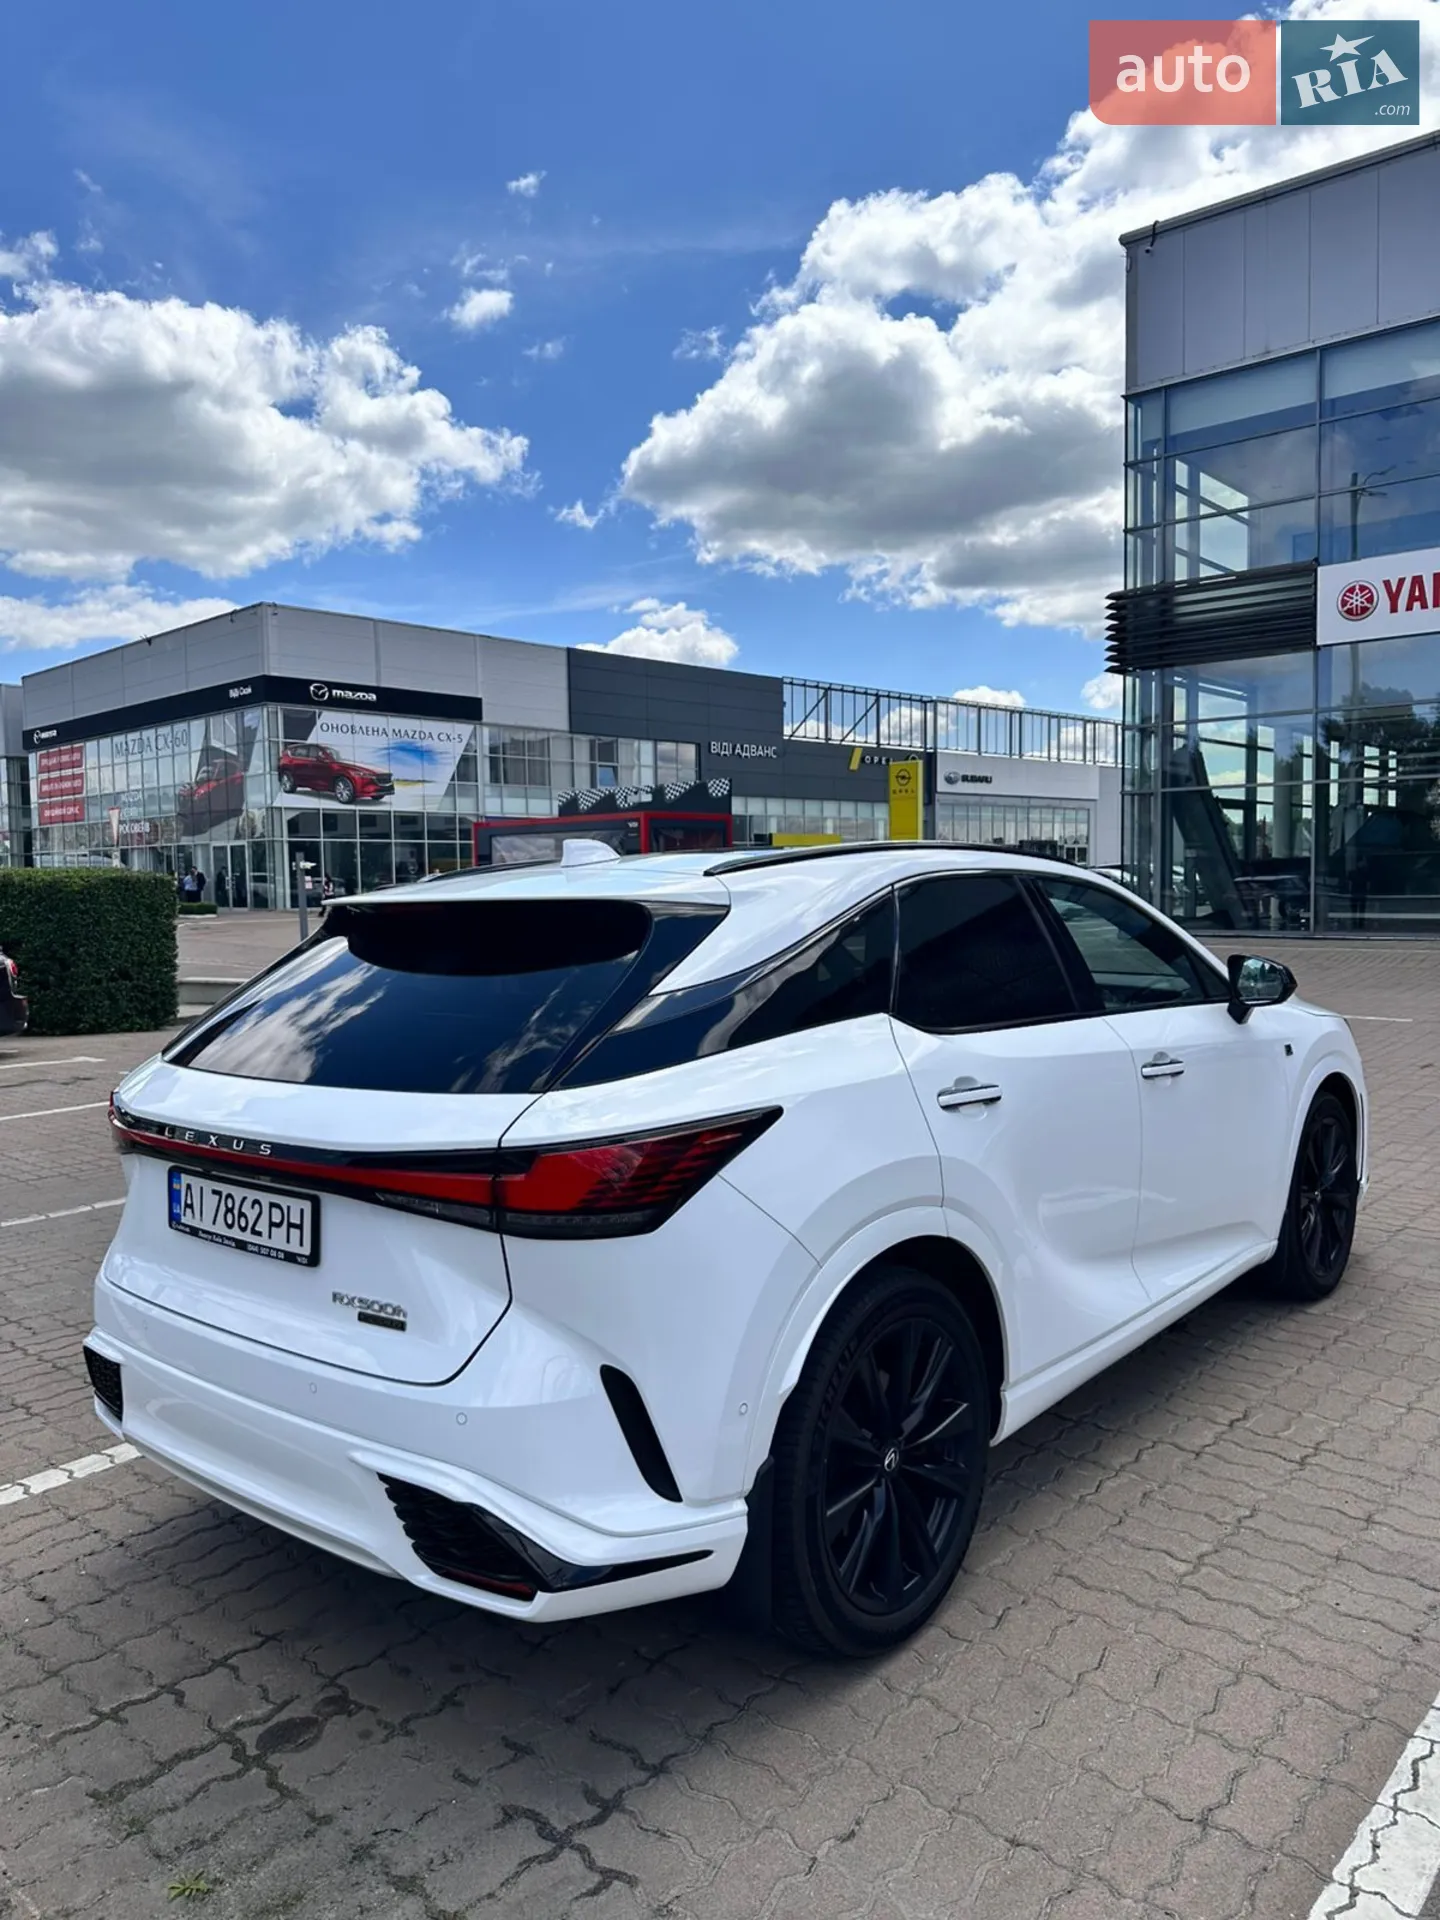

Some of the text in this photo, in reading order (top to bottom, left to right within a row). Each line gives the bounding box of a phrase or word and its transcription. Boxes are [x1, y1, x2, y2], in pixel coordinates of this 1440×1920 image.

[331, 687, 377, 702] mazda
[114, 729, 188, 759] MAZDA CX-60
[320, 722, 463, 743] ОНОВЛЕНА MAZDA CX-5
[710, 741, 777, 759] ВІДІ АДВАНС
[164, 1128, 273, 1155] LEXUS
[183, 1183, 304, 1248] AI 7862 PH
